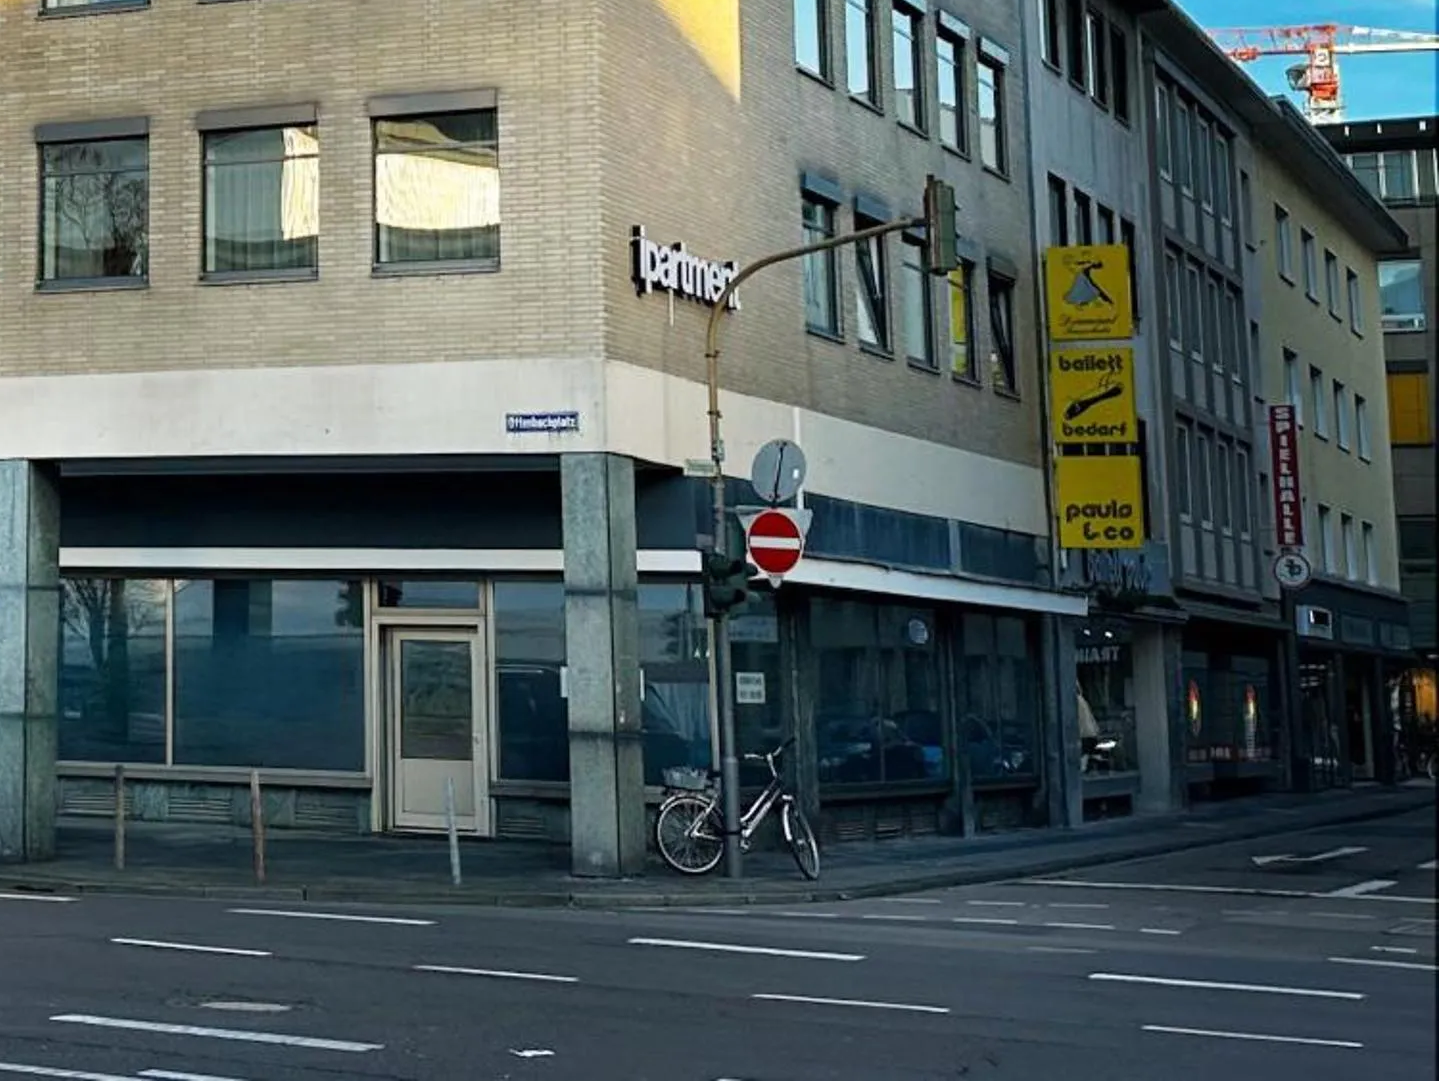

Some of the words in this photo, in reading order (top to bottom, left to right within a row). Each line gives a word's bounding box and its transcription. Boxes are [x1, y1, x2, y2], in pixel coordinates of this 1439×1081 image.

[1059, 354, 1124, 373] ballett
[1062, 421, 1128, 437] bedarf
[1274, 407, 1296, 544] SPIELHALLE
[1066, 499, 1133, 524] paula
[1103, 525, 1135, 541] co
